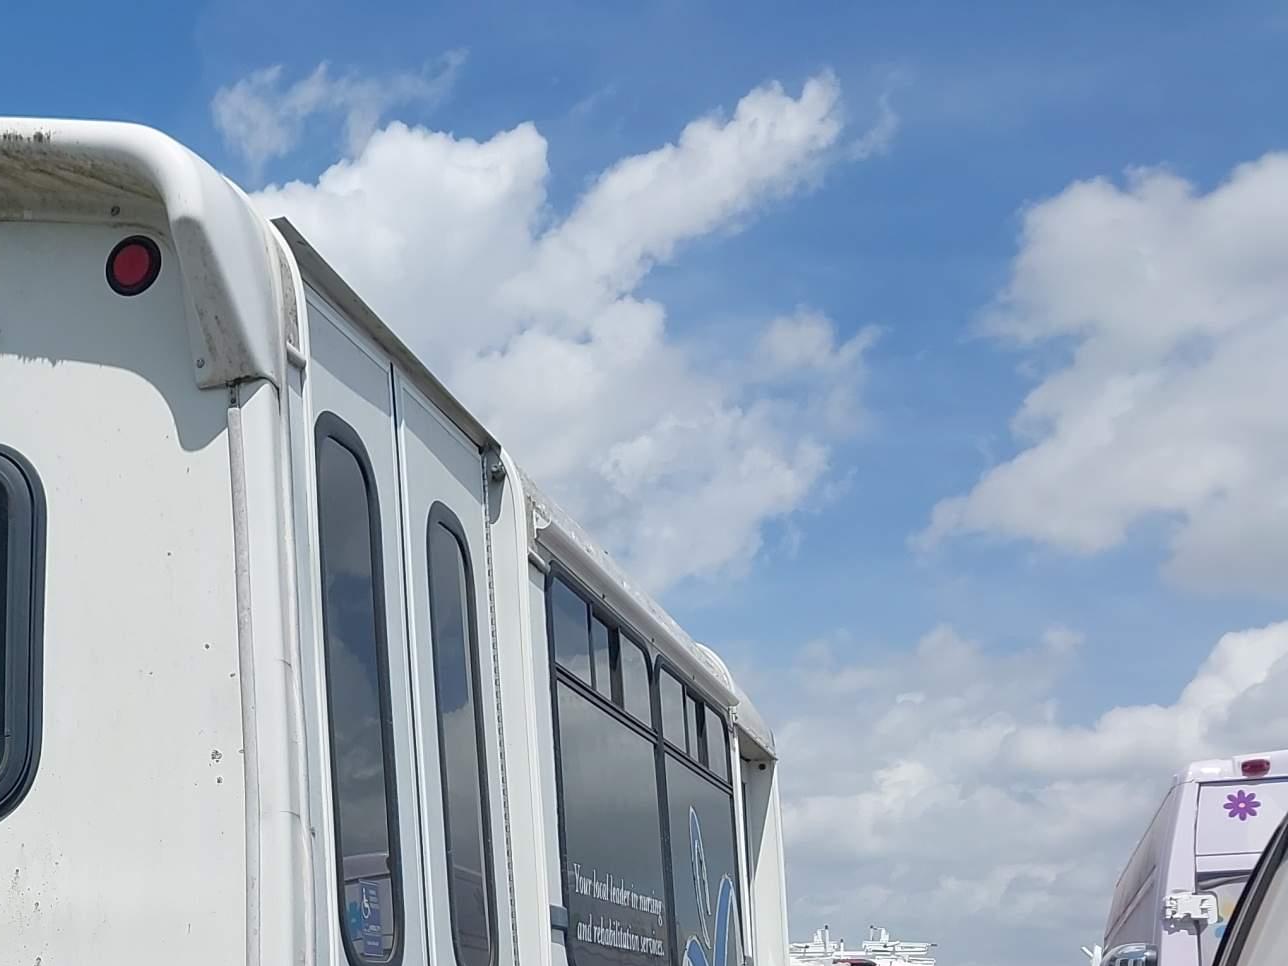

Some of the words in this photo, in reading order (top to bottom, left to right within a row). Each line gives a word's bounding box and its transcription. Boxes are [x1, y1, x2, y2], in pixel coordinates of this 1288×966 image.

[573, 863, 592, 896] Your
[593, 869, 609, 900] local
[610, 874, 630, 907] leader
[631, 883, 638, 910] in
[639, 889, 663, 927] nursing
[577, 913, 592, 943] and
[593, 916, 640, 953] rehabilitation
